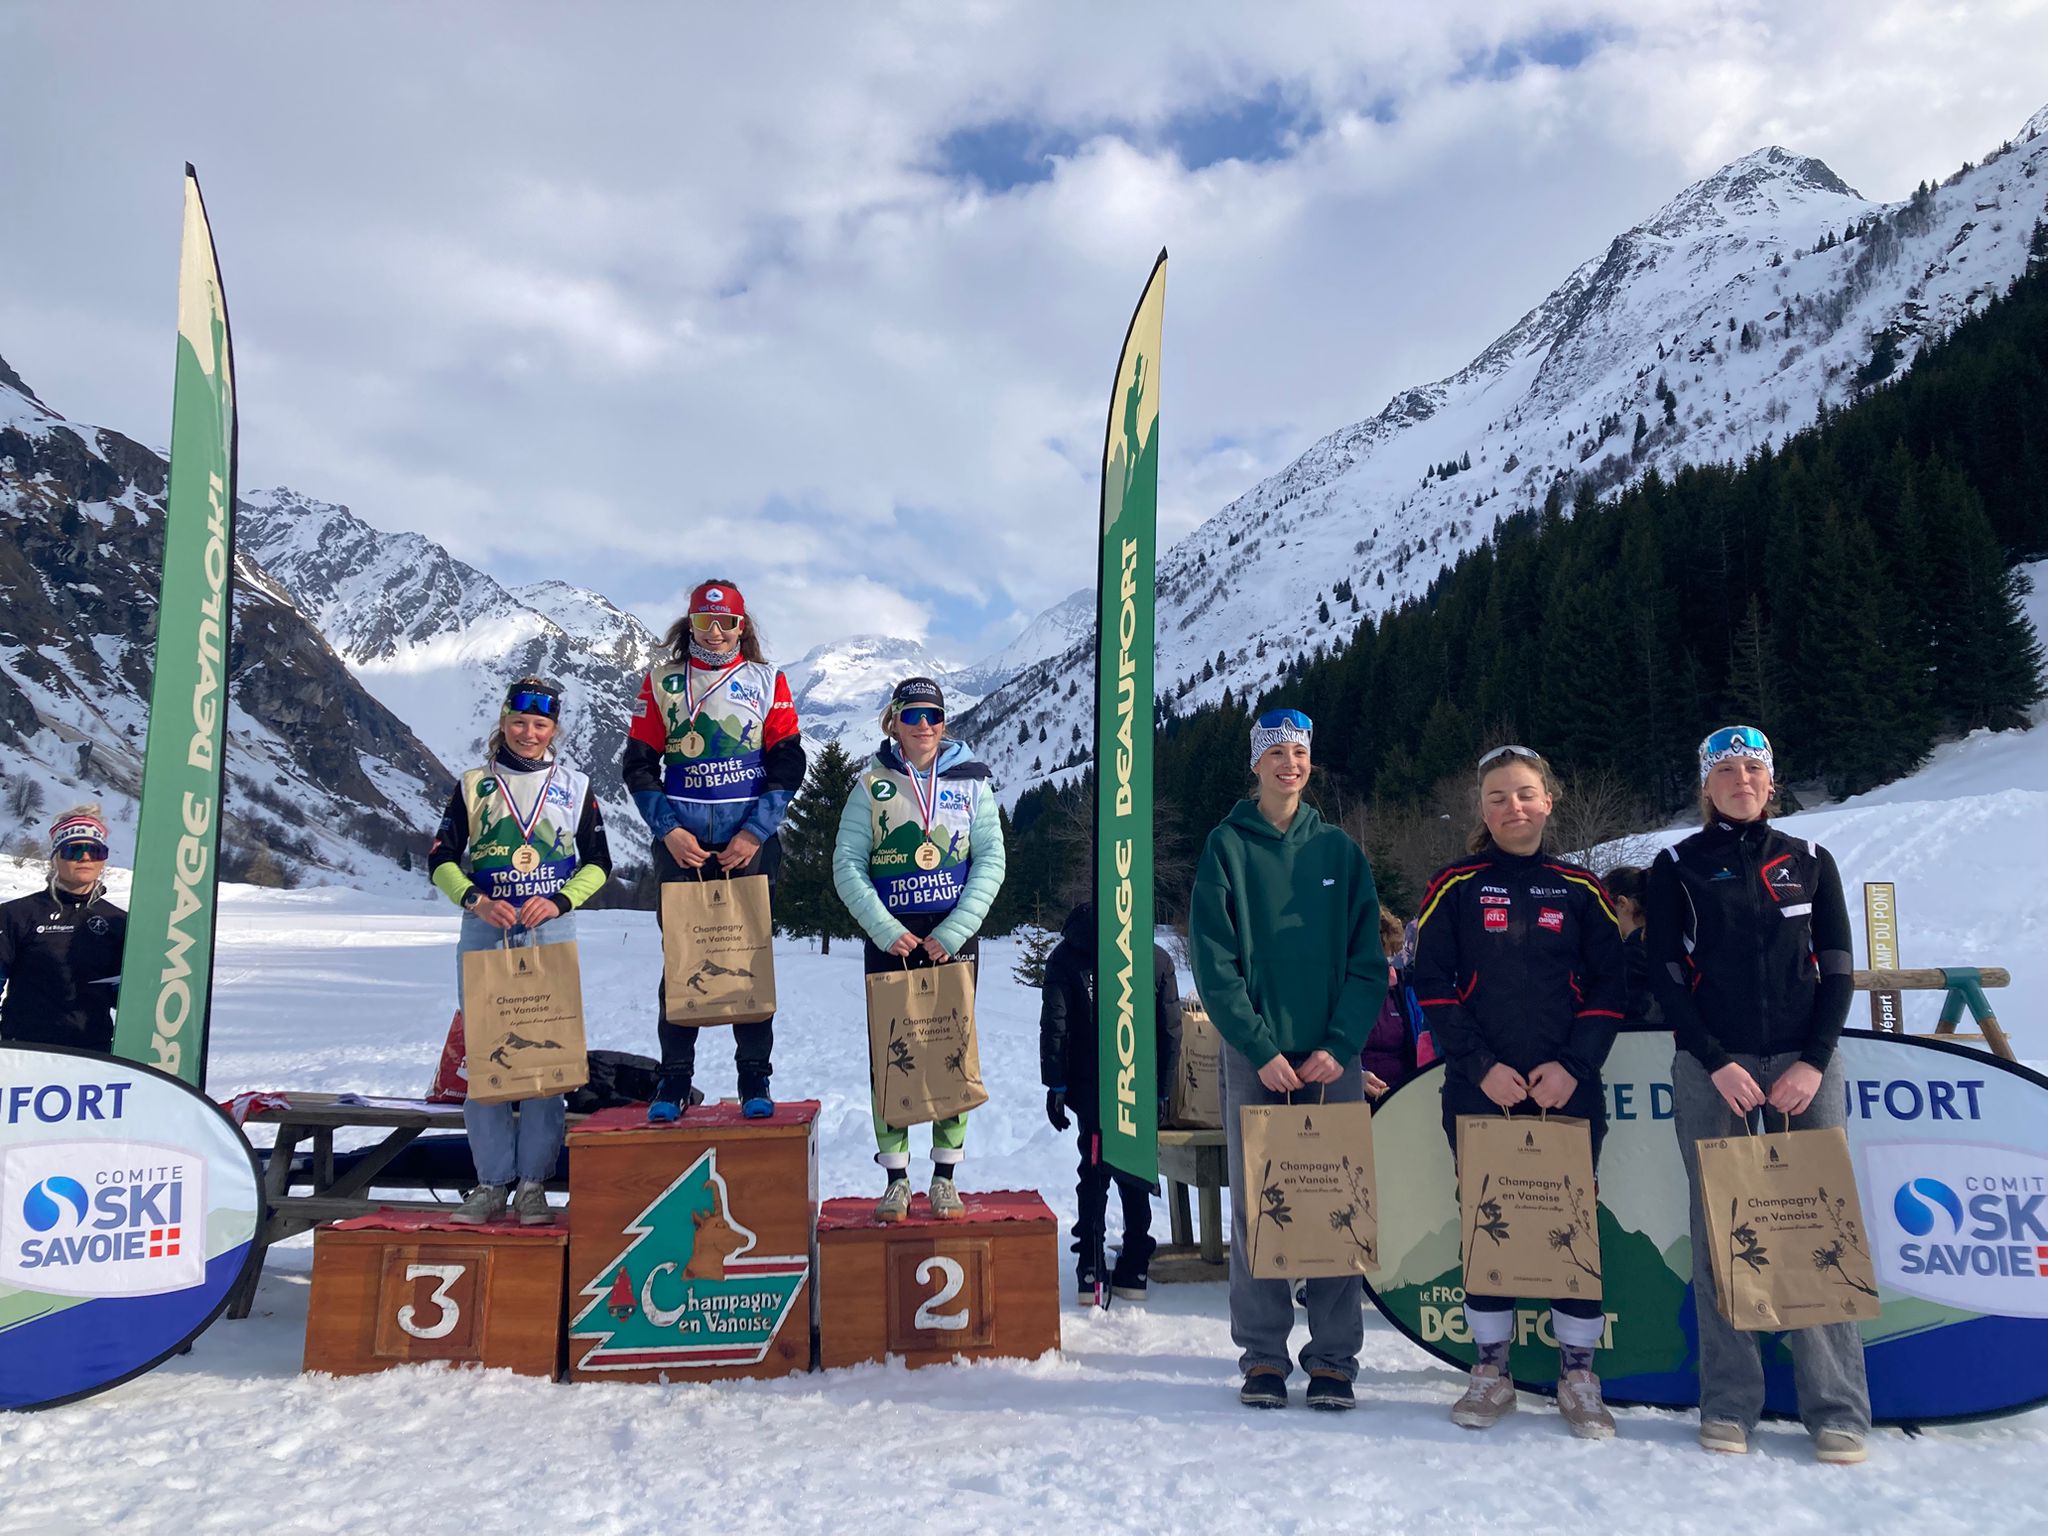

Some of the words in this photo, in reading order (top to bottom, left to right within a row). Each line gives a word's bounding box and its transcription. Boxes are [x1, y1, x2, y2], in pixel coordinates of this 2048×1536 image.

[669, 676, 678, 690] 1
[1115, 537, 1137, 817] BEAUFORT
[684, 758, 743, 776] TROPHÉE
[684, 777, 702, 788] DU
[705, 766, 767, 788] BEAUFORT
[877, 782, 891, 798] 2
[520, 852, 532, 865] 3
[923, 849, 933, 861] 2
[491, 864, 555, 883] TROPHÉE
[891, 870, 954, 893] TROPHÉE
[492, 885, 512, 898] DU
[515, 879, 569, 897] BEAUFO
[888, 893, 909, 907] DU
[1872, 885, 1889, 919] PONT
[692, 924, 744, 934] Champagny
[1875, 923, 1891, 940] DU
[708, 934, 742, 943] Vanoise
[1876, 945, 1893, 970] AMP
[1115, 838, 1137, 1138] FROMAGE
[496, 993, 551, 1005] Champagny
[513, 1004, 549, 1014] Vanoise
[918, 1026, 950, 1036] Vanoise
[0, 1083, 132, 1124] FORT
[1280, 1160, 1341, 1172] Champagny
[95, 1166, 183, 1185] COMITE
[1299, 1174, 1339, 1184] Vanoise
[1498, 1176, 1562, 1190] Champagny
[91, 1181, 182, 1230] SKI
[1518, 1191, 1560, 1202] Vanoise
[1748, 1197, 1818, 1208] Champagny
[1755, 1215, 1768, 1223] en
[1771, 1210, 1818, 1221] Vanoise
[19, 1230, 146, 1269] SAVOIE
[1899, 1243, 2035, 1277] SAVOIE
[397, 1263, 466, 1340] 3
[641, 1261, 782, 1327] Champagny
[915, 1256, 969, 1331] 2
[1432, 1286, 1466, 1302] FRO
[679, 1319, 700, 1333] en
[703, 1311, 771, 1333] Vanoise
[1421, 1306, 1618, 1350] BEFOT
